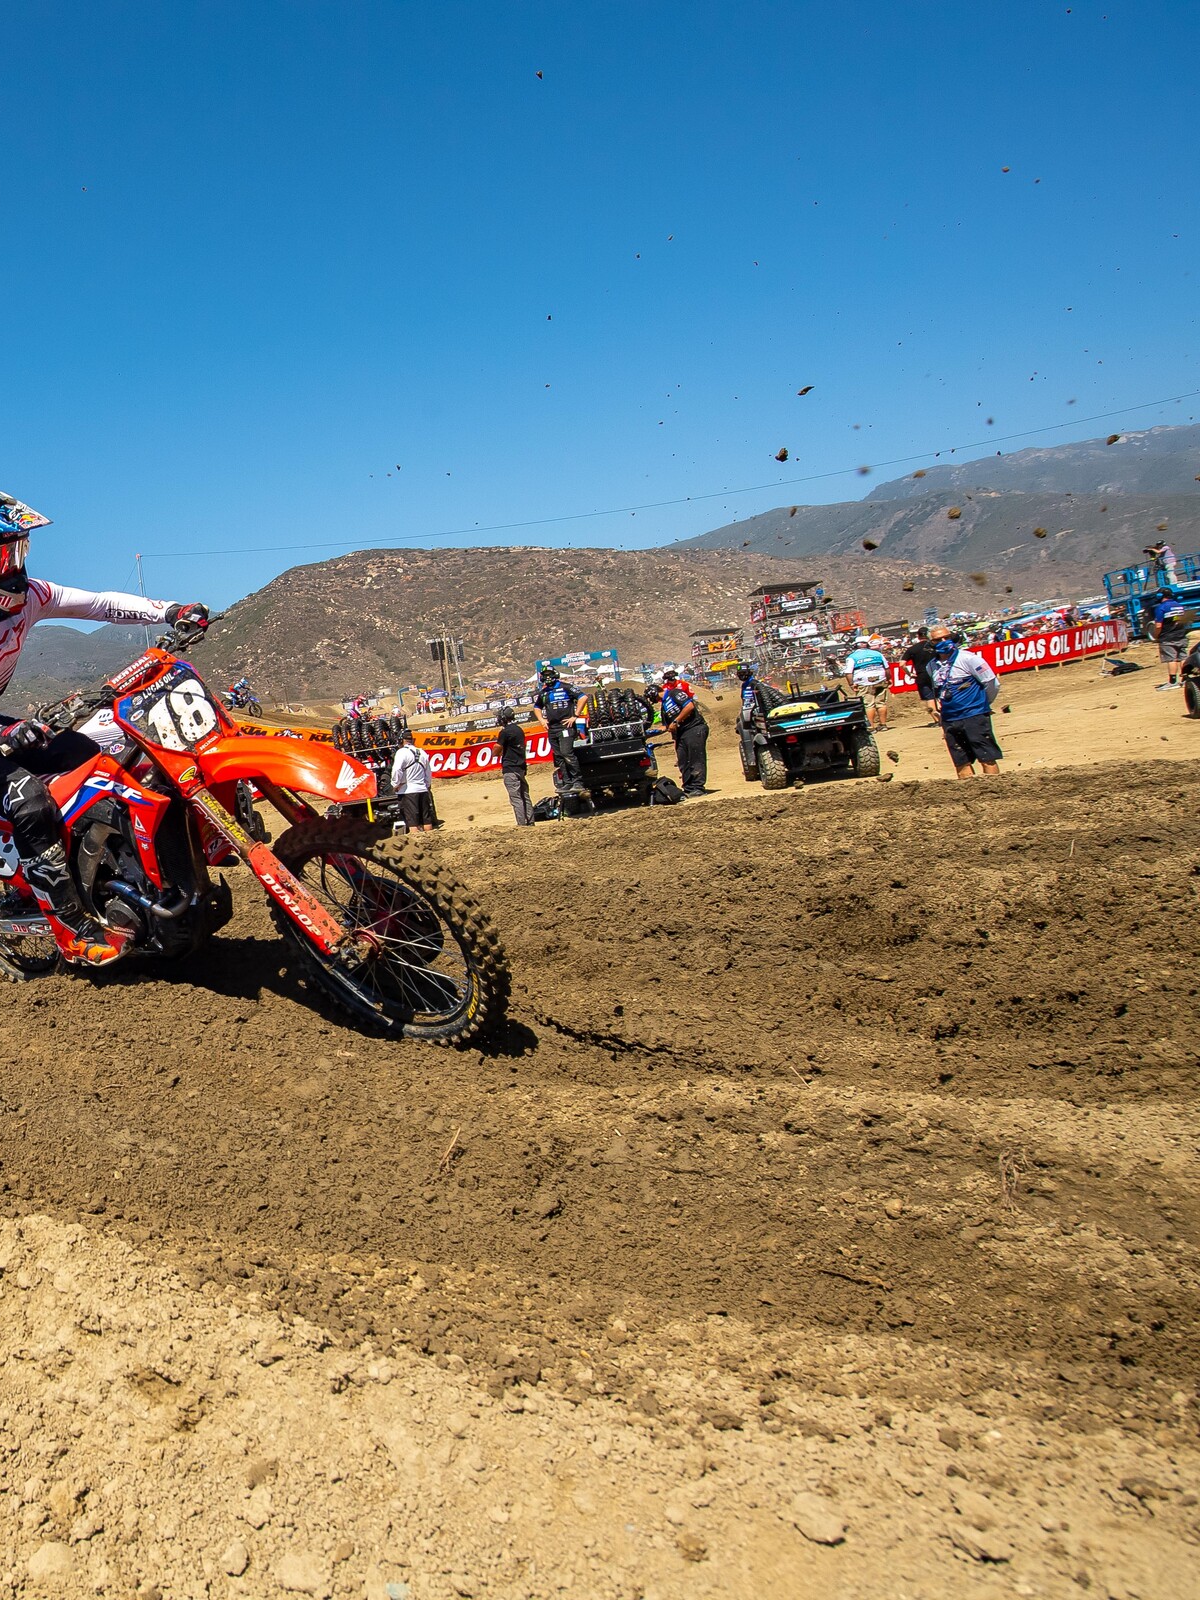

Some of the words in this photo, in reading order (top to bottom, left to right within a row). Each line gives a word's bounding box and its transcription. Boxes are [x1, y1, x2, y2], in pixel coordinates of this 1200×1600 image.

[995, 638, 1046, 667] LUCAS
[1049, 635, 1070, 656] OIL
[1074, 625, 1105, 651] LUCAS
[142, 681, 164, 699] LUCAS
[163, 673, 175, 684] OIL
[148, 679, 216, 752] 18
[241, 726, 267, 736] KTM
[424, 735, 456, 746] KTM
[427, 750, 471, 773] CAS
[84, 776, 142, 799] CRF
[344, 773, 370, 795] HONDA
[260, 873, 322, 936] DUNLOP
